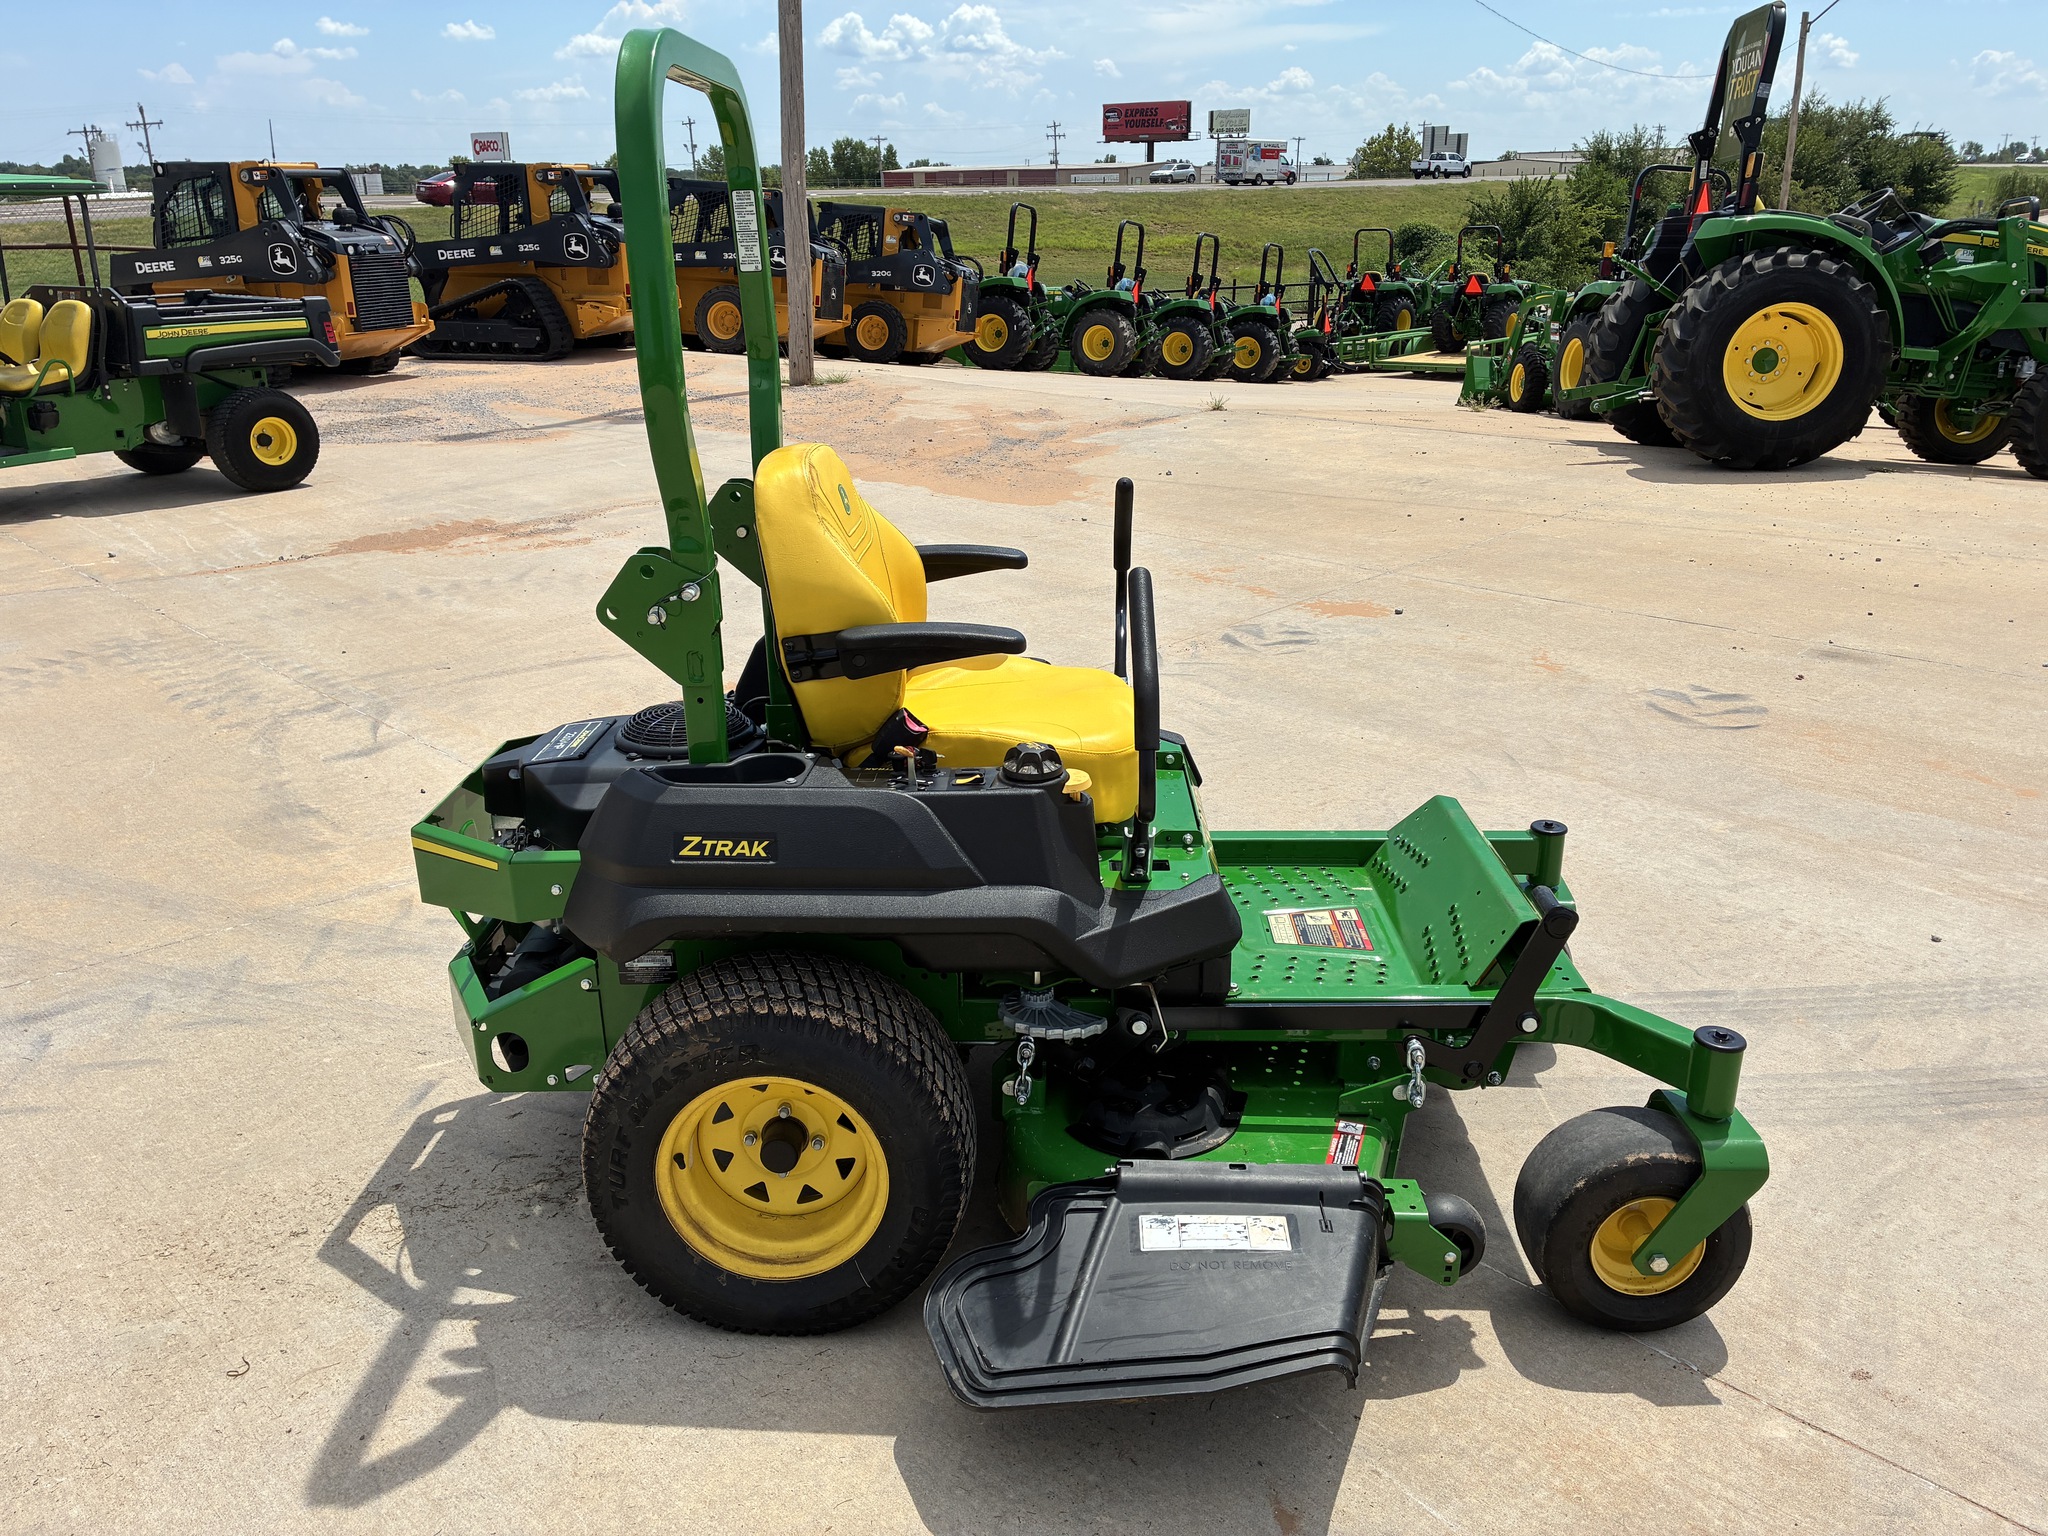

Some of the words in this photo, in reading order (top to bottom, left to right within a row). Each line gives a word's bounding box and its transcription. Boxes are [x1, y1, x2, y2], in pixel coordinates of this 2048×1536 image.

[1729, 69, 1760, 101] TRUST
[1124, 107, 1159, 118] EXPRESS
[1124, 118, 1166, 129] YOURSELF.
[473, 138, 499, 156] CRAFCO
[437, 248, 476, 261] DEERE
[518, 243, 540, 253] 325G
[1988, 239, 2000, 248] JO
[2027, 246, 2044, 255] ERE
[135, 260, 176, 274] DEERE
[219, 255, 243, 265] 325G
[157, 330, 180, 339] JOHN
[181, 327, 209, 336] DEERE
[678, 836, 770, 857] ZTRAK
[608, 1125, 632, 1210] TURF
[1169, 1261, 1191, 1272] DO
[1198, 1260, 1226, 1270] NOT
[1233, 1260, 1293, 1271] REMOVE
